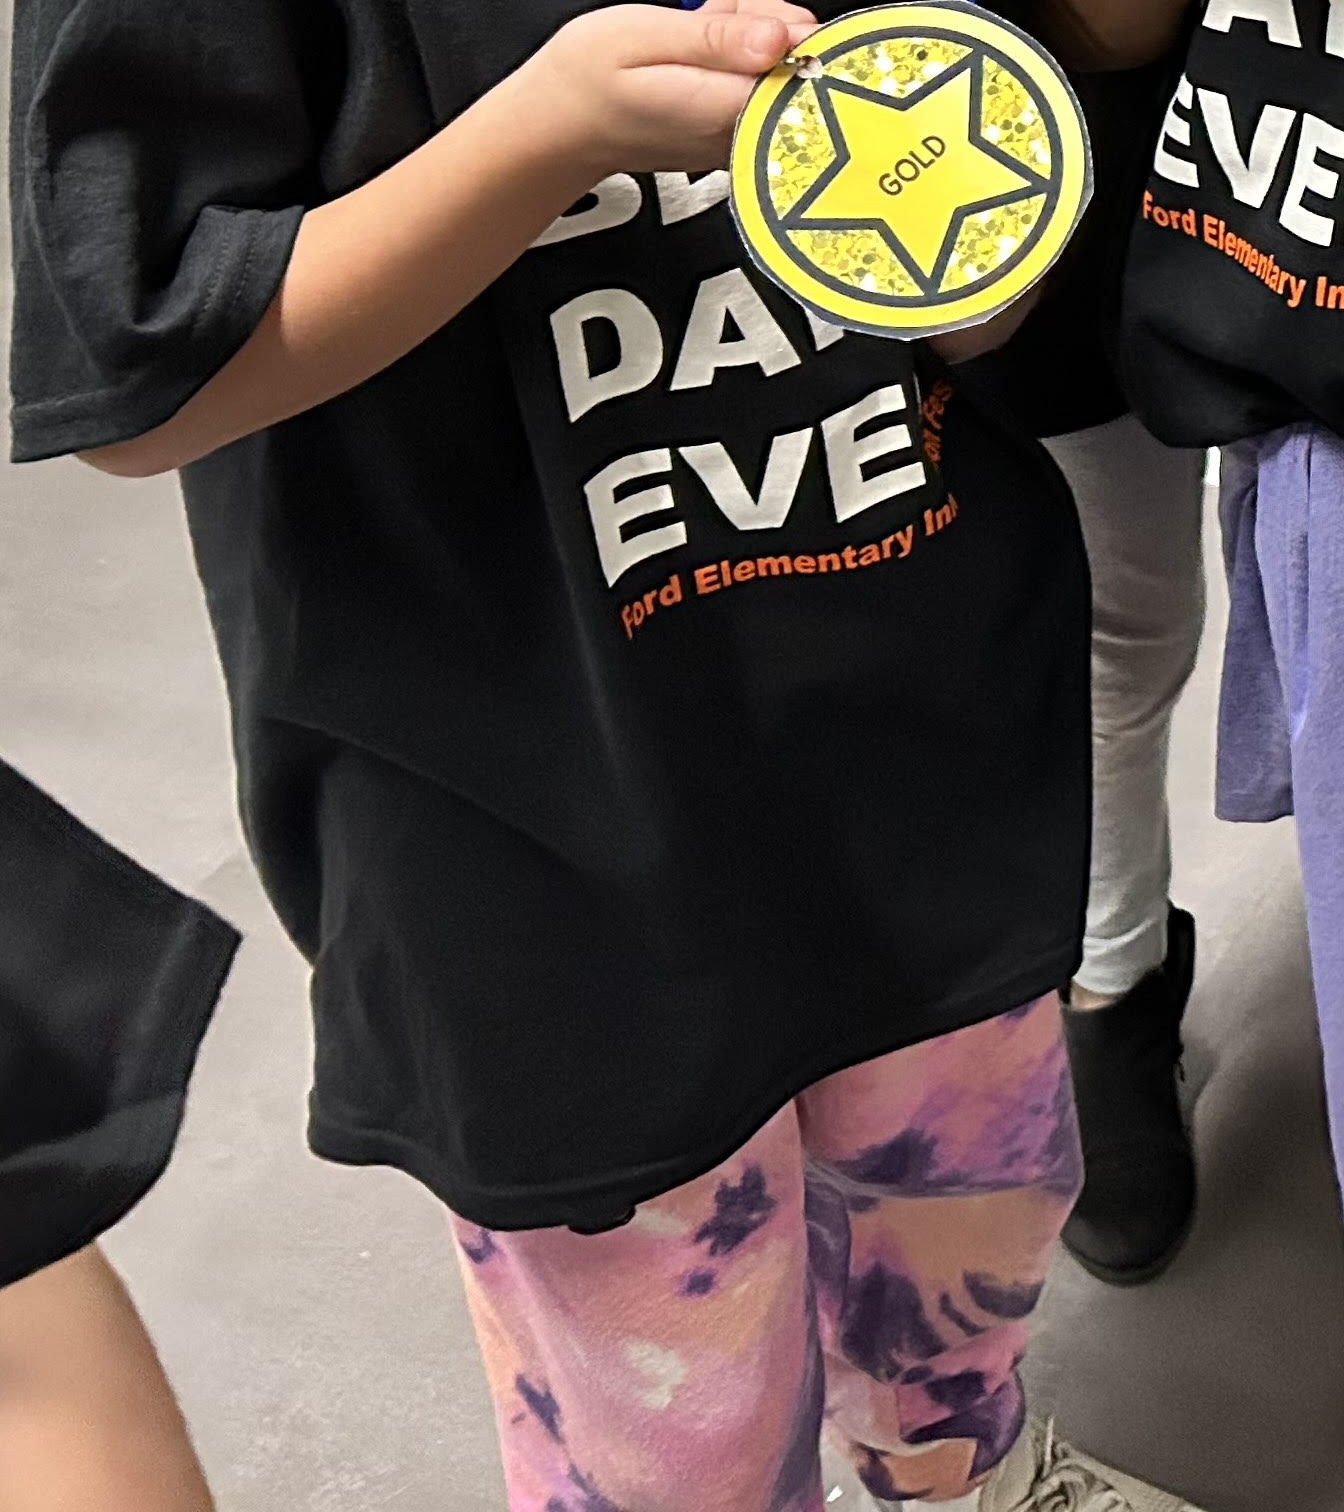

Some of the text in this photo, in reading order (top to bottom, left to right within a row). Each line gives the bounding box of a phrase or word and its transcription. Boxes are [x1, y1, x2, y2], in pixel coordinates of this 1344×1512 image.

[878, 135, 947, 196] GOLD
[1142, 190, 1198, 238] Ford
[1202, 213, 1307, 309] Elementary
[549, 267, 845, 424] DA
[583, 383, 927, 588] EVE
[620, 524, 915, 641] Ford Elementary
